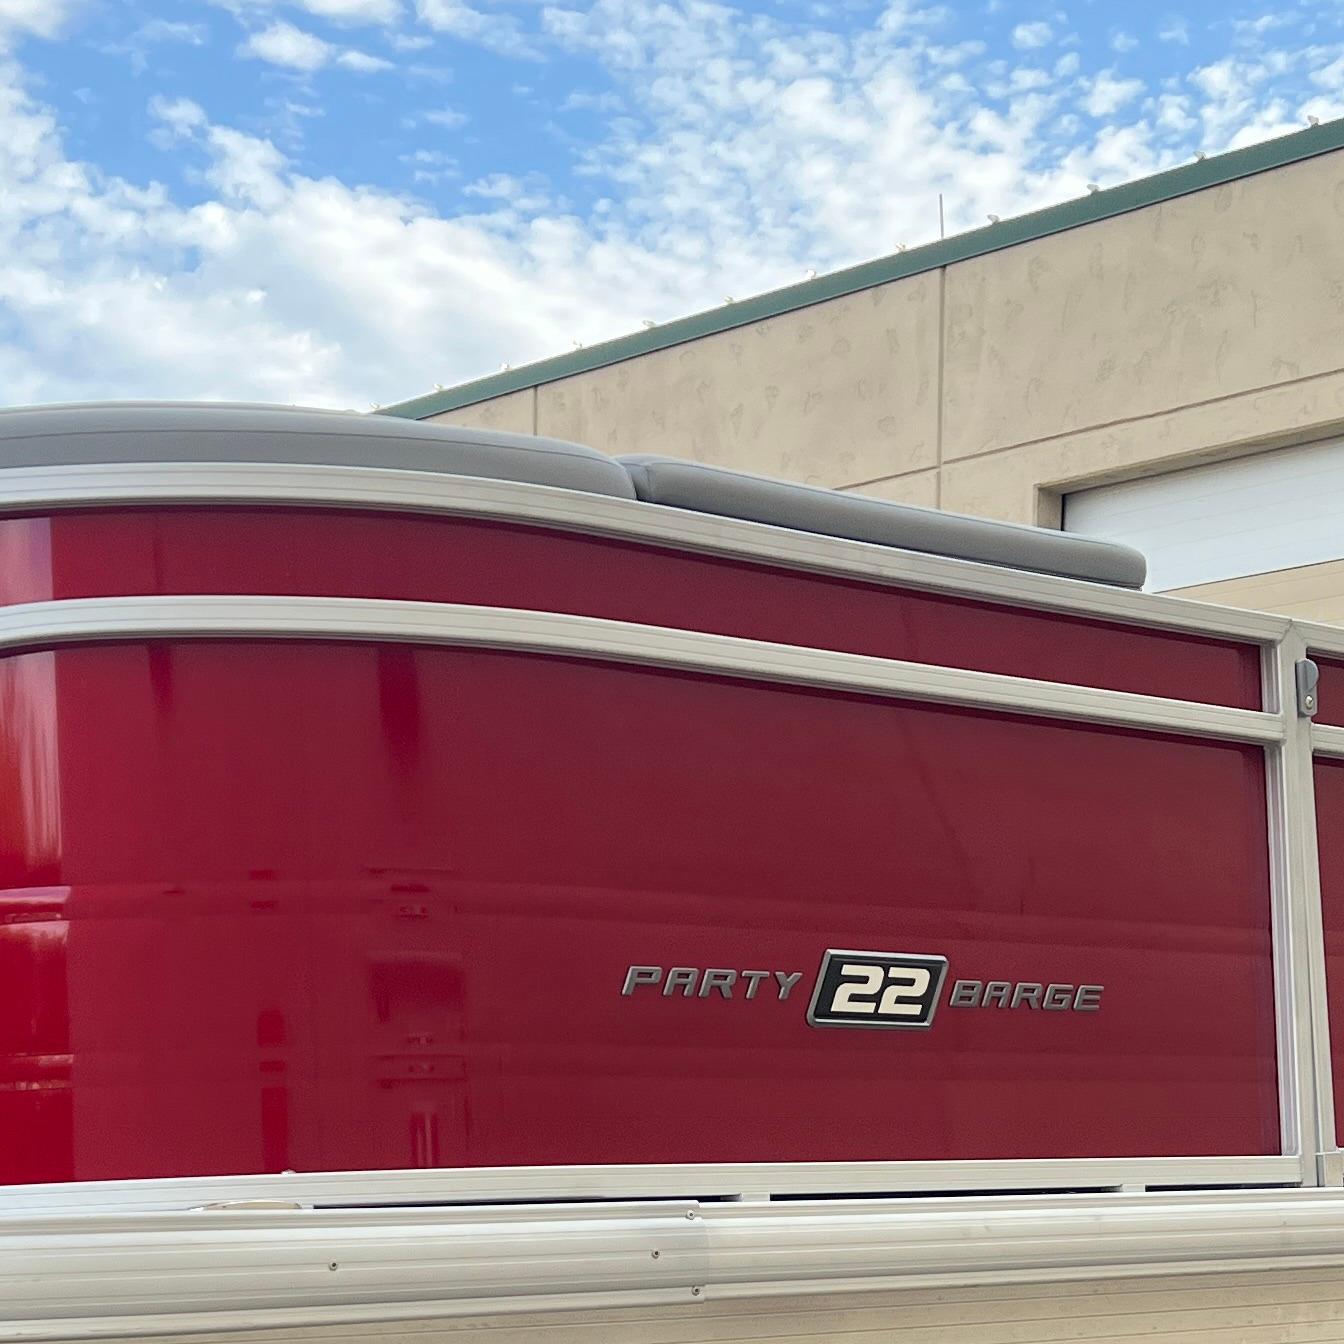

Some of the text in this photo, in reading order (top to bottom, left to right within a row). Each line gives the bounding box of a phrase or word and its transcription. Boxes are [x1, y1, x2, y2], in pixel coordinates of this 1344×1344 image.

[621, 963, 1105, 1016] PARTY 22 BARGE
